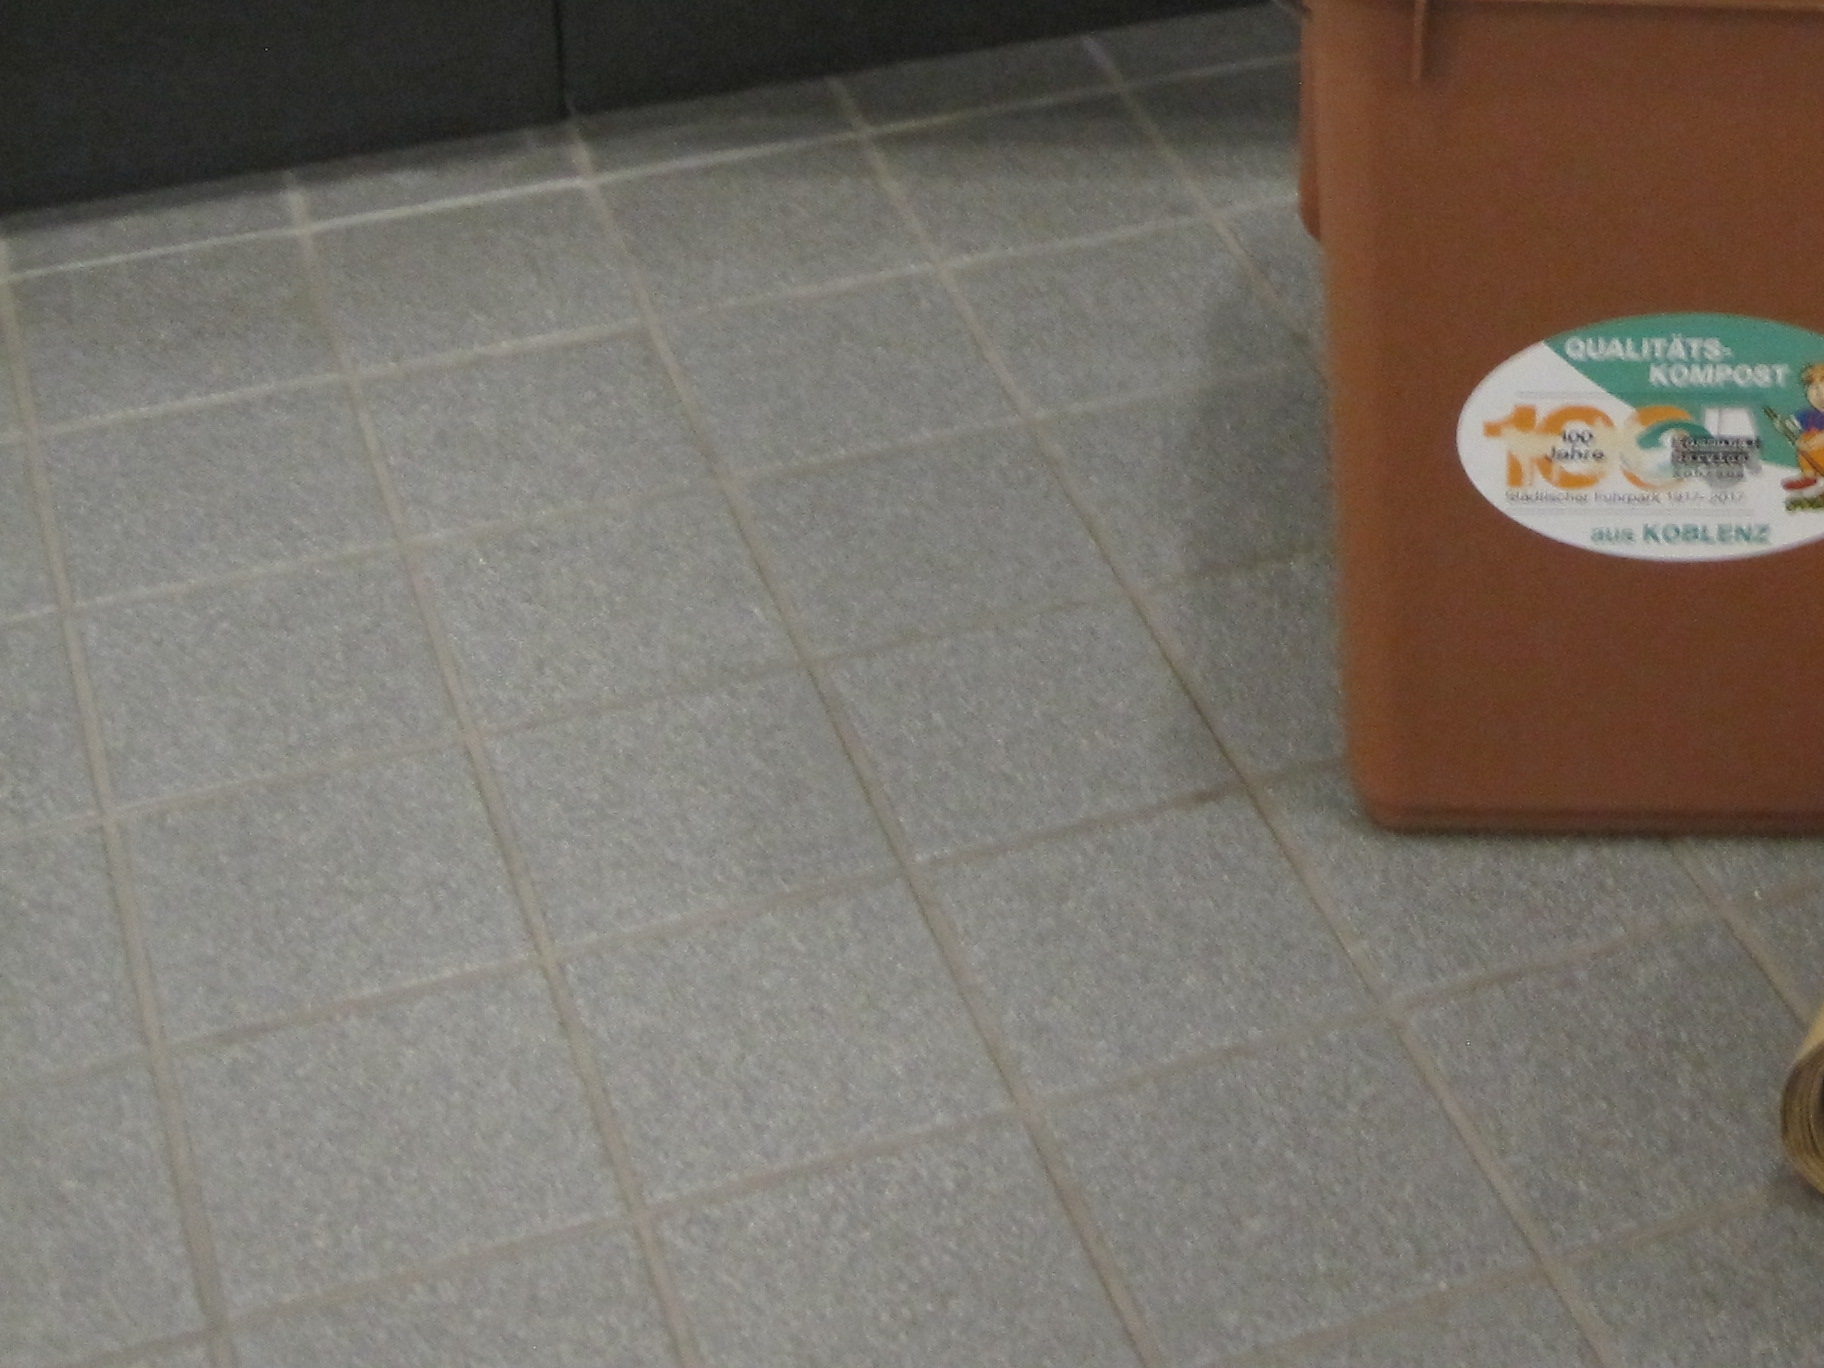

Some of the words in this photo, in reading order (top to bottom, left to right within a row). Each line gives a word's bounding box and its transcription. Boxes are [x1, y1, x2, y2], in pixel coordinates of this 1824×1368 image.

[1564, 332, 1733, 362] QUALITÄTS-
[1649, 363, 1790, 388] KOMPOST
[1562, 429, 1594, 444] 100
[1547, 445, 1605, 462] Jahre
[1590, 527, 1635, 543] aus
[1641, 523, 1771, 544] KOBLENZ
